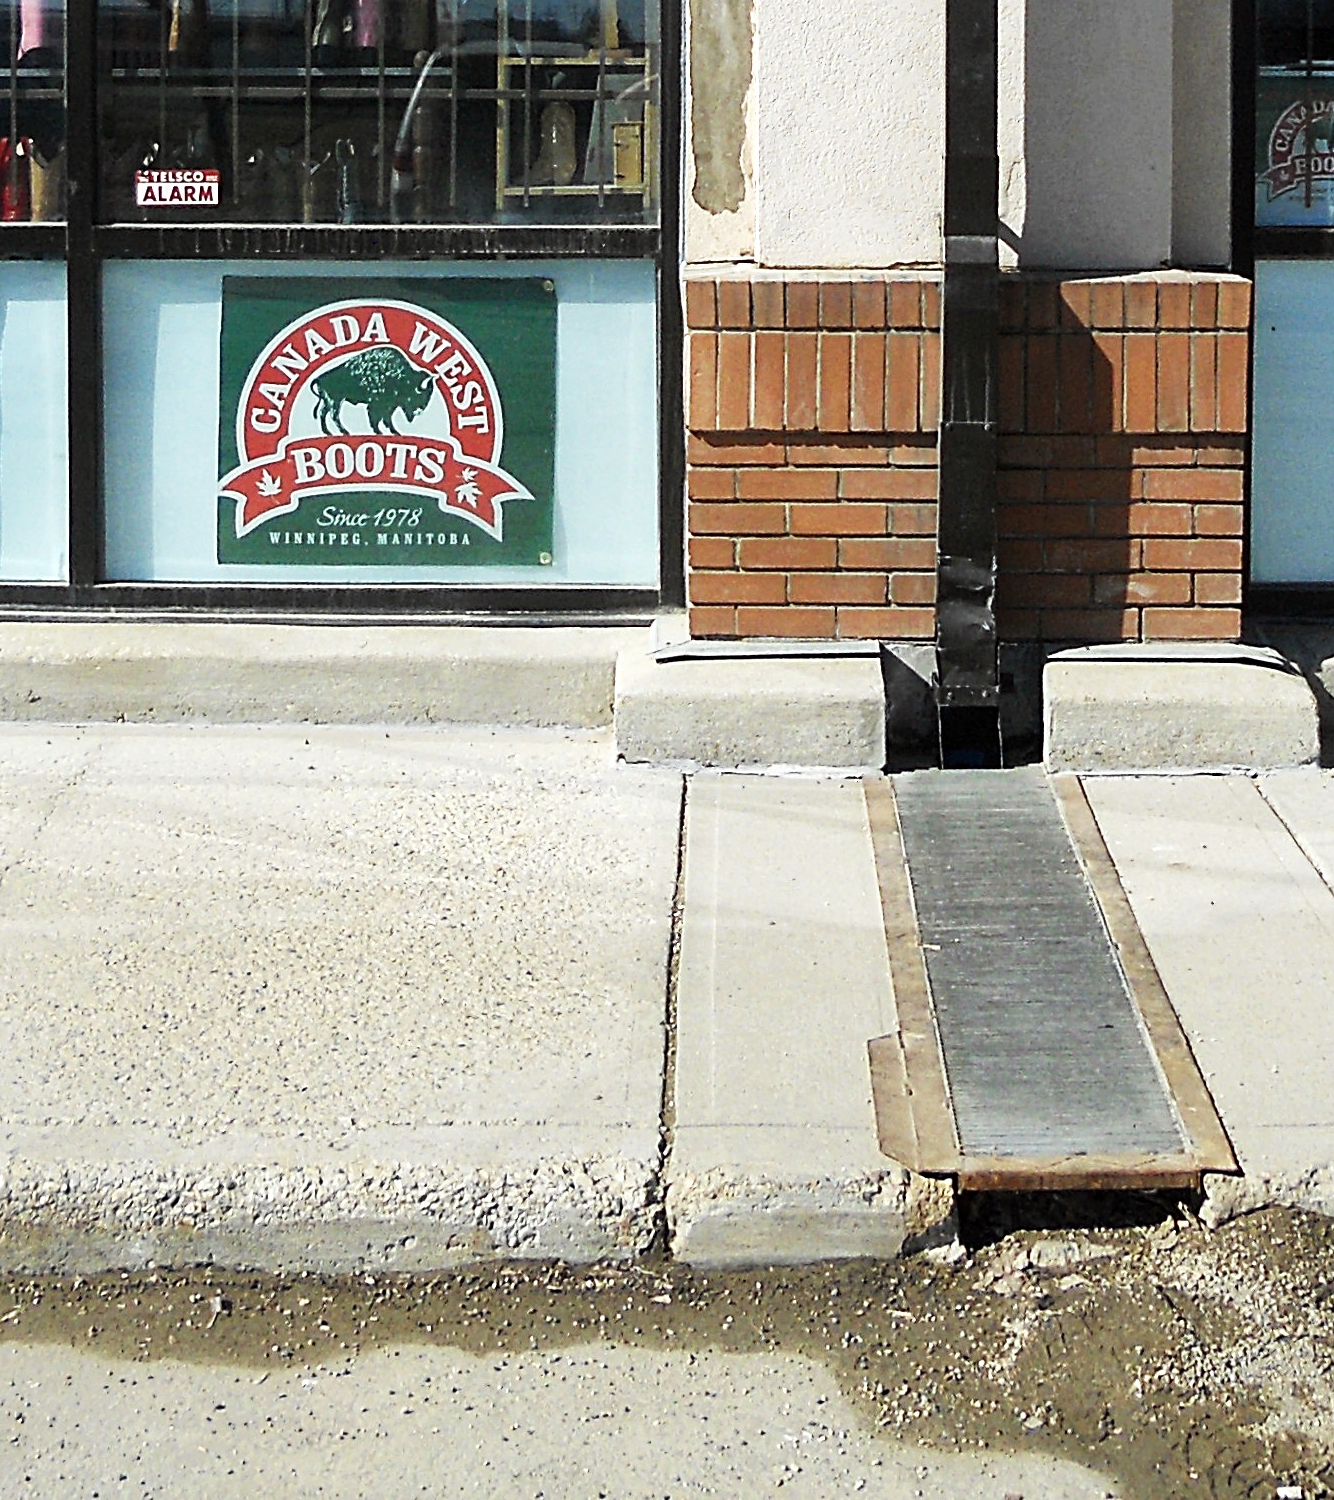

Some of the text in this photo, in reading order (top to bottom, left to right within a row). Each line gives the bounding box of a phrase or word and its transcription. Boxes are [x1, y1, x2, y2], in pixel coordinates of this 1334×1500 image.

[150, 171, 205, 182] TELSCO
[142, 185, 214, 202] ALARM
[249, 311, 491, 436] CANADA WEST
[289, 441, 448, 485] BOOTS
[316, 505, 423, 527] Since 1978
[376, 532, 471, 546] MANITOBA
